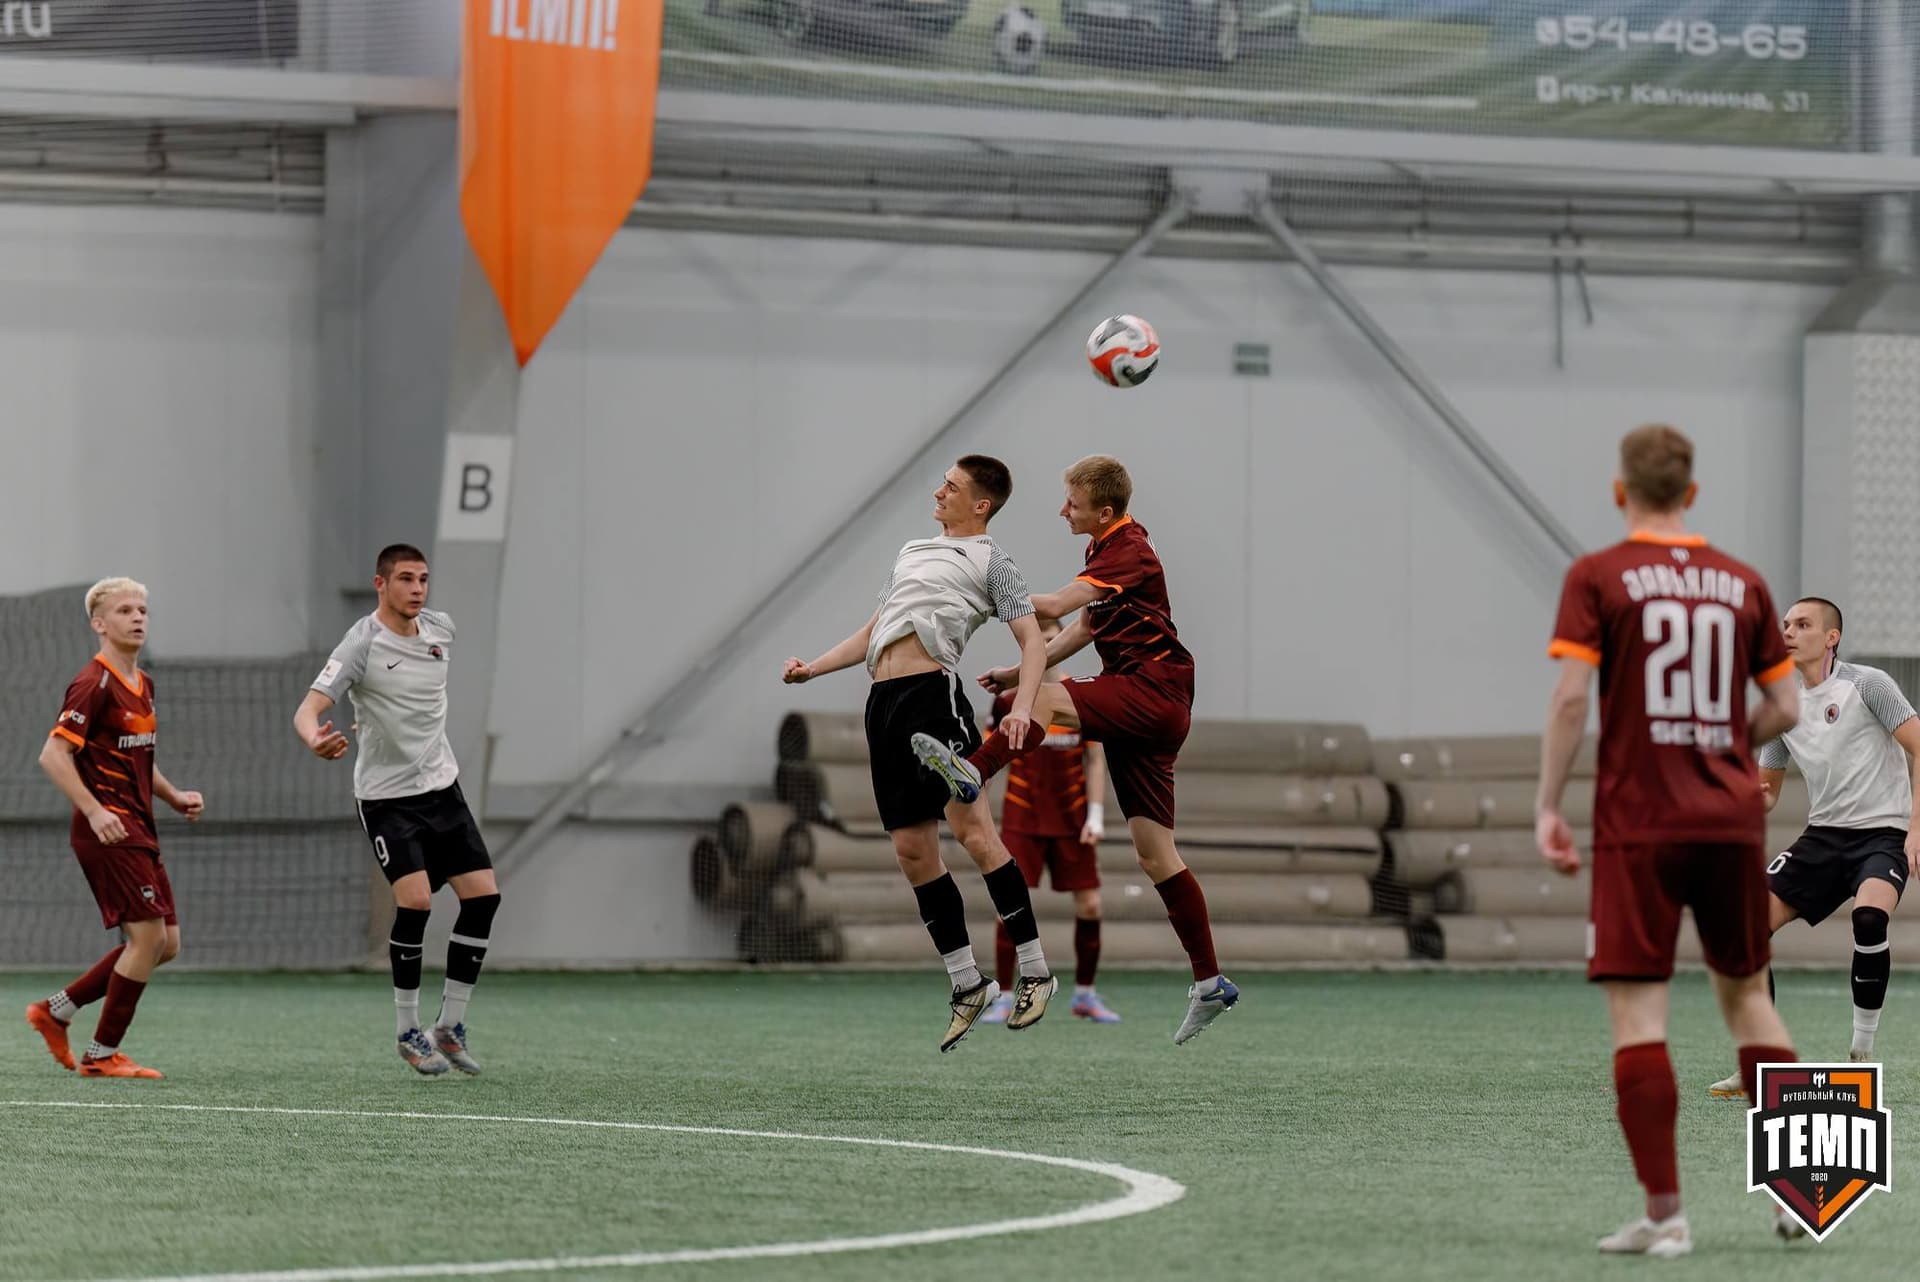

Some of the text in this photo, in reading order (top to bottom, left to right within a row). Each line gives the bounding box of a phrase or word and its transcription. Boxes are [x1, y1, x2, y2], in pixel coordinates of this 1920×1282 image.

[0, 1, 51, 37] ru
[1564, 15, 1808, 60] 54-48-65
[1783, 91, 1809, 113] 31
[1621, 564, 1745, 609] ЗАВЬЯЛОВ
[1642, 600, 1735, 722] 20
[375, 835, 389, 867] 9
